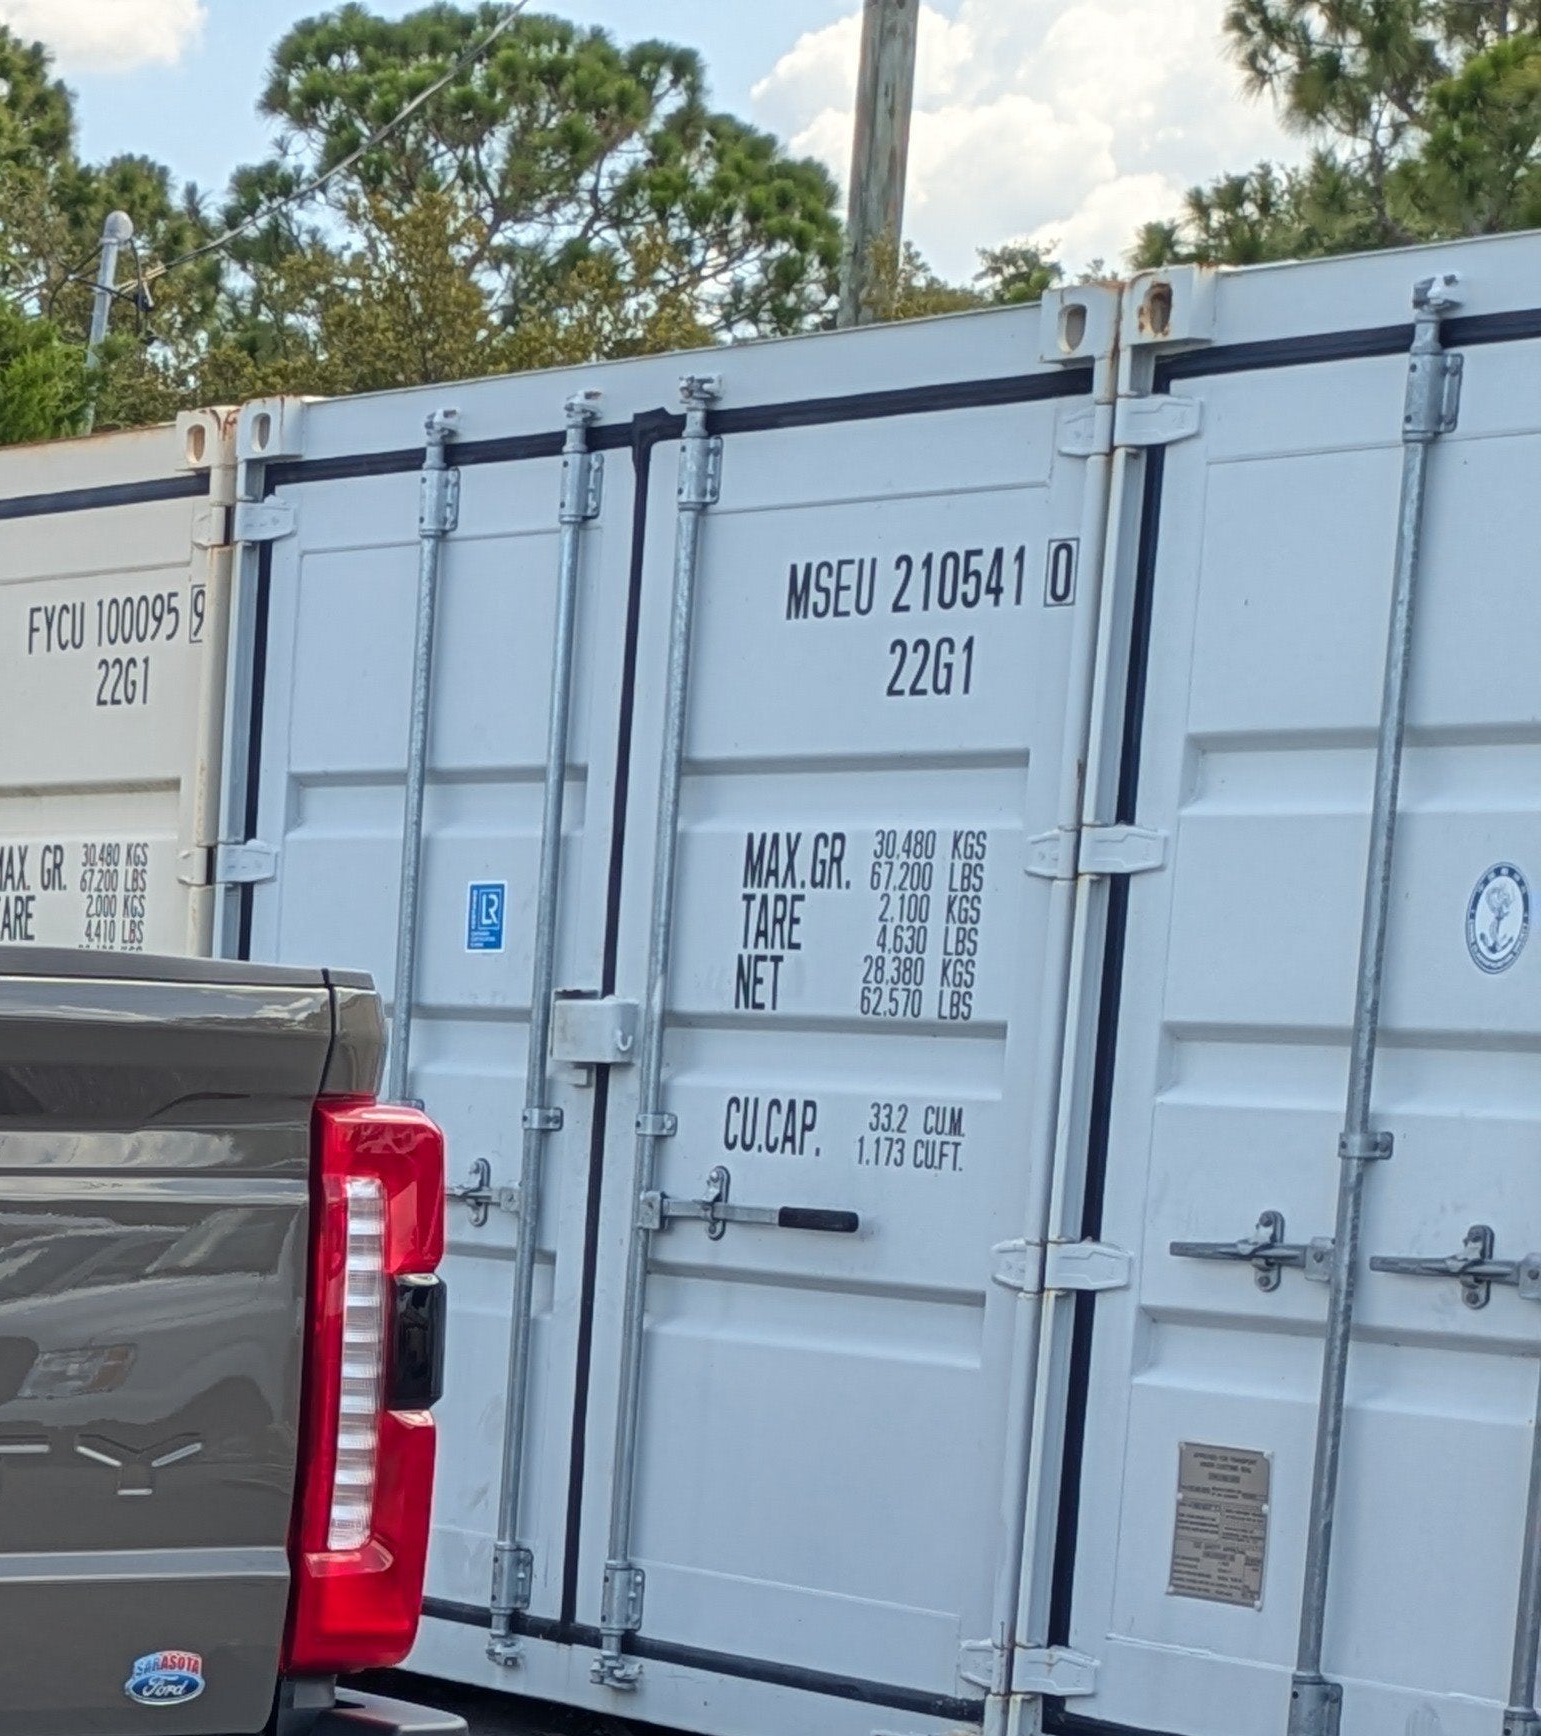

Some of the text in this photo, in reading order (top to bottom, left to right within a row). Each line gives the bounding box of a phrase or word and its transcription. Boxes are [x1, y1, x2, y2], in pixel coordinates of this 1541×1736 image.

[785, 557, 877, 620] MSEU
[892, 545, 1027, 614] 210541
[28, 601, 85, 655] FYCU
[96, 592, 180, 647] 100095
[96, 656, 149, 706] 22G1
[886, 635, 975, 697] 22G1
[951, 830, 987, 861] KGS
[40, 844, 67, 892] GR.
[124, 842, 149, 868] KGS
[124, 868, 147, 893] LBS
[948, 862, 984, 893] LBS
[121, 894, 146, 919] KGS
[742, 893, 806, 950] TARE
[944, 894, 982, 926] KGS
[120, 919, 144, 944] LBS
[943, 926, 979, 957] LBS
[734, 953, 784, 1010] NET
[939, 958, 976, 989] KGS
[937, 989, 973, 1021] LBS
[869, 1102, 909, 1134] 33.2
[858, 1135, 906, 1168] 1.173
[142, 1675, 188, 1697] Ford
